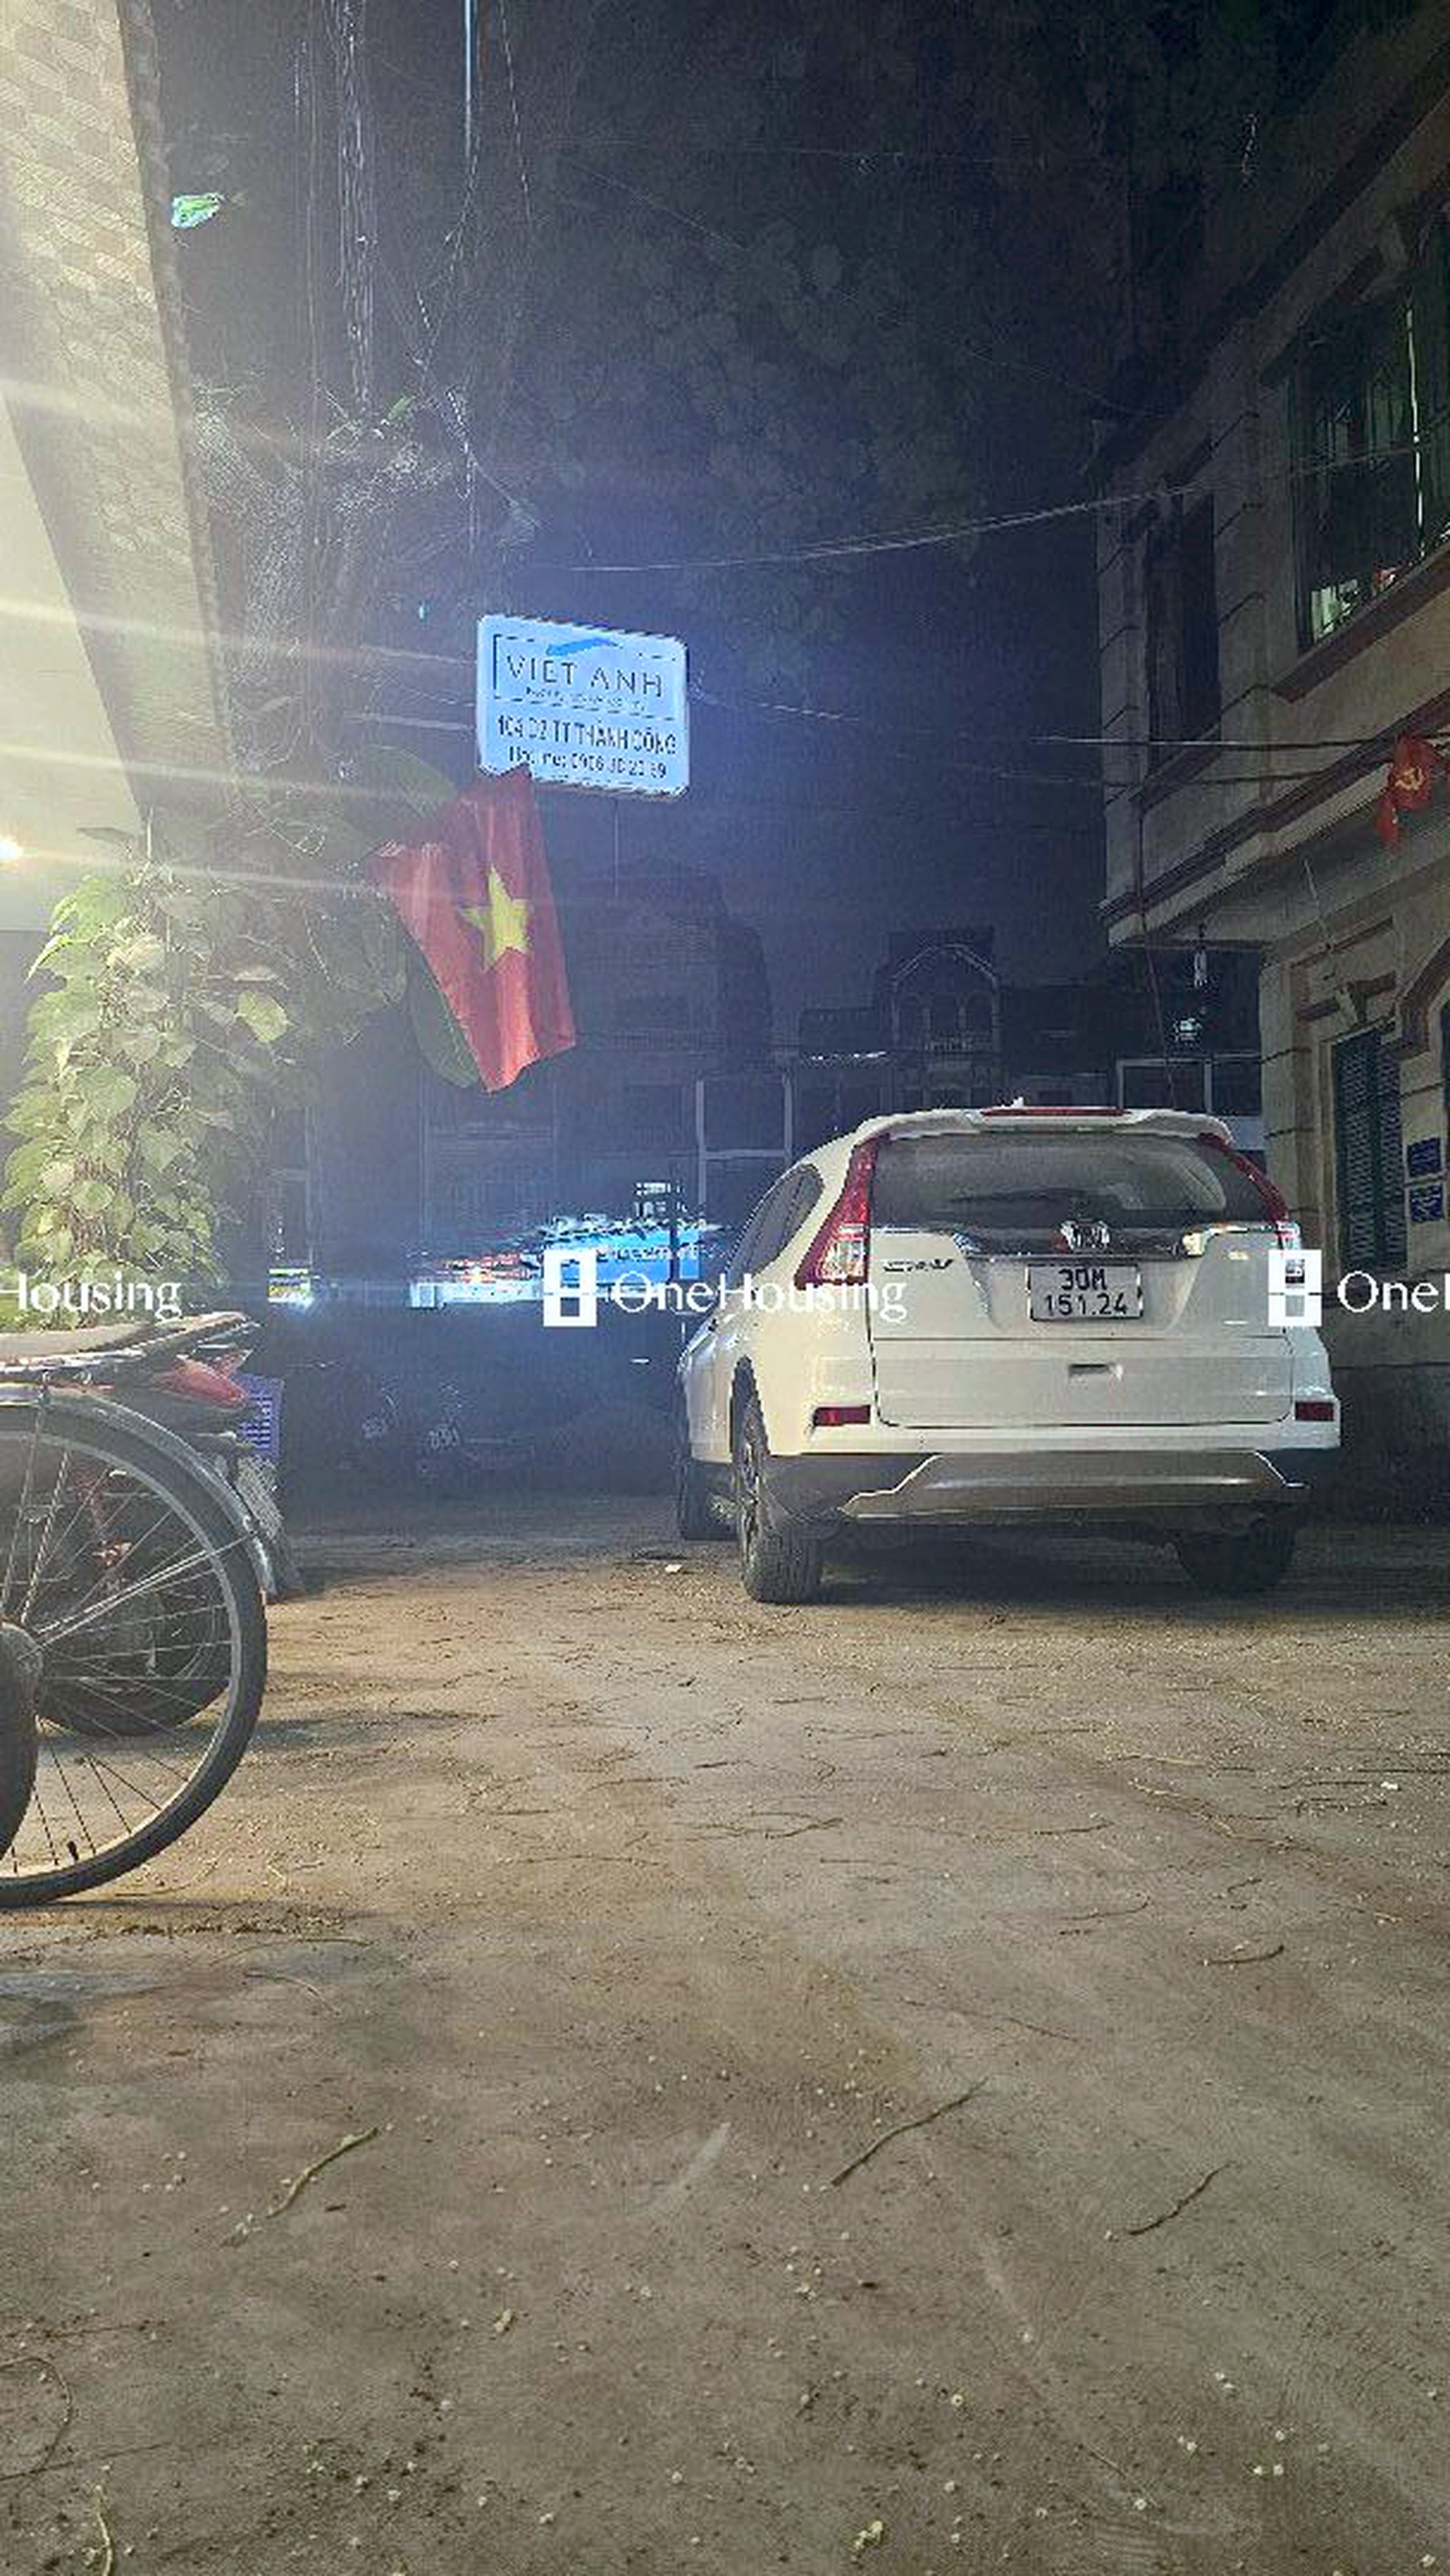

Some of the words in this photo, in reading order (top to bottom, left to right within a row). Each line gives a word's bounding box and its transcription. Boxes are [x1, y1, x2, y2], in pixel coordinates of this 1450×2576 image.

[590, 667, 662, 698] ANH
[1057, 1268, 1107, 1291] 30M
[1045, 1292, 1128, 1316] 151.24
